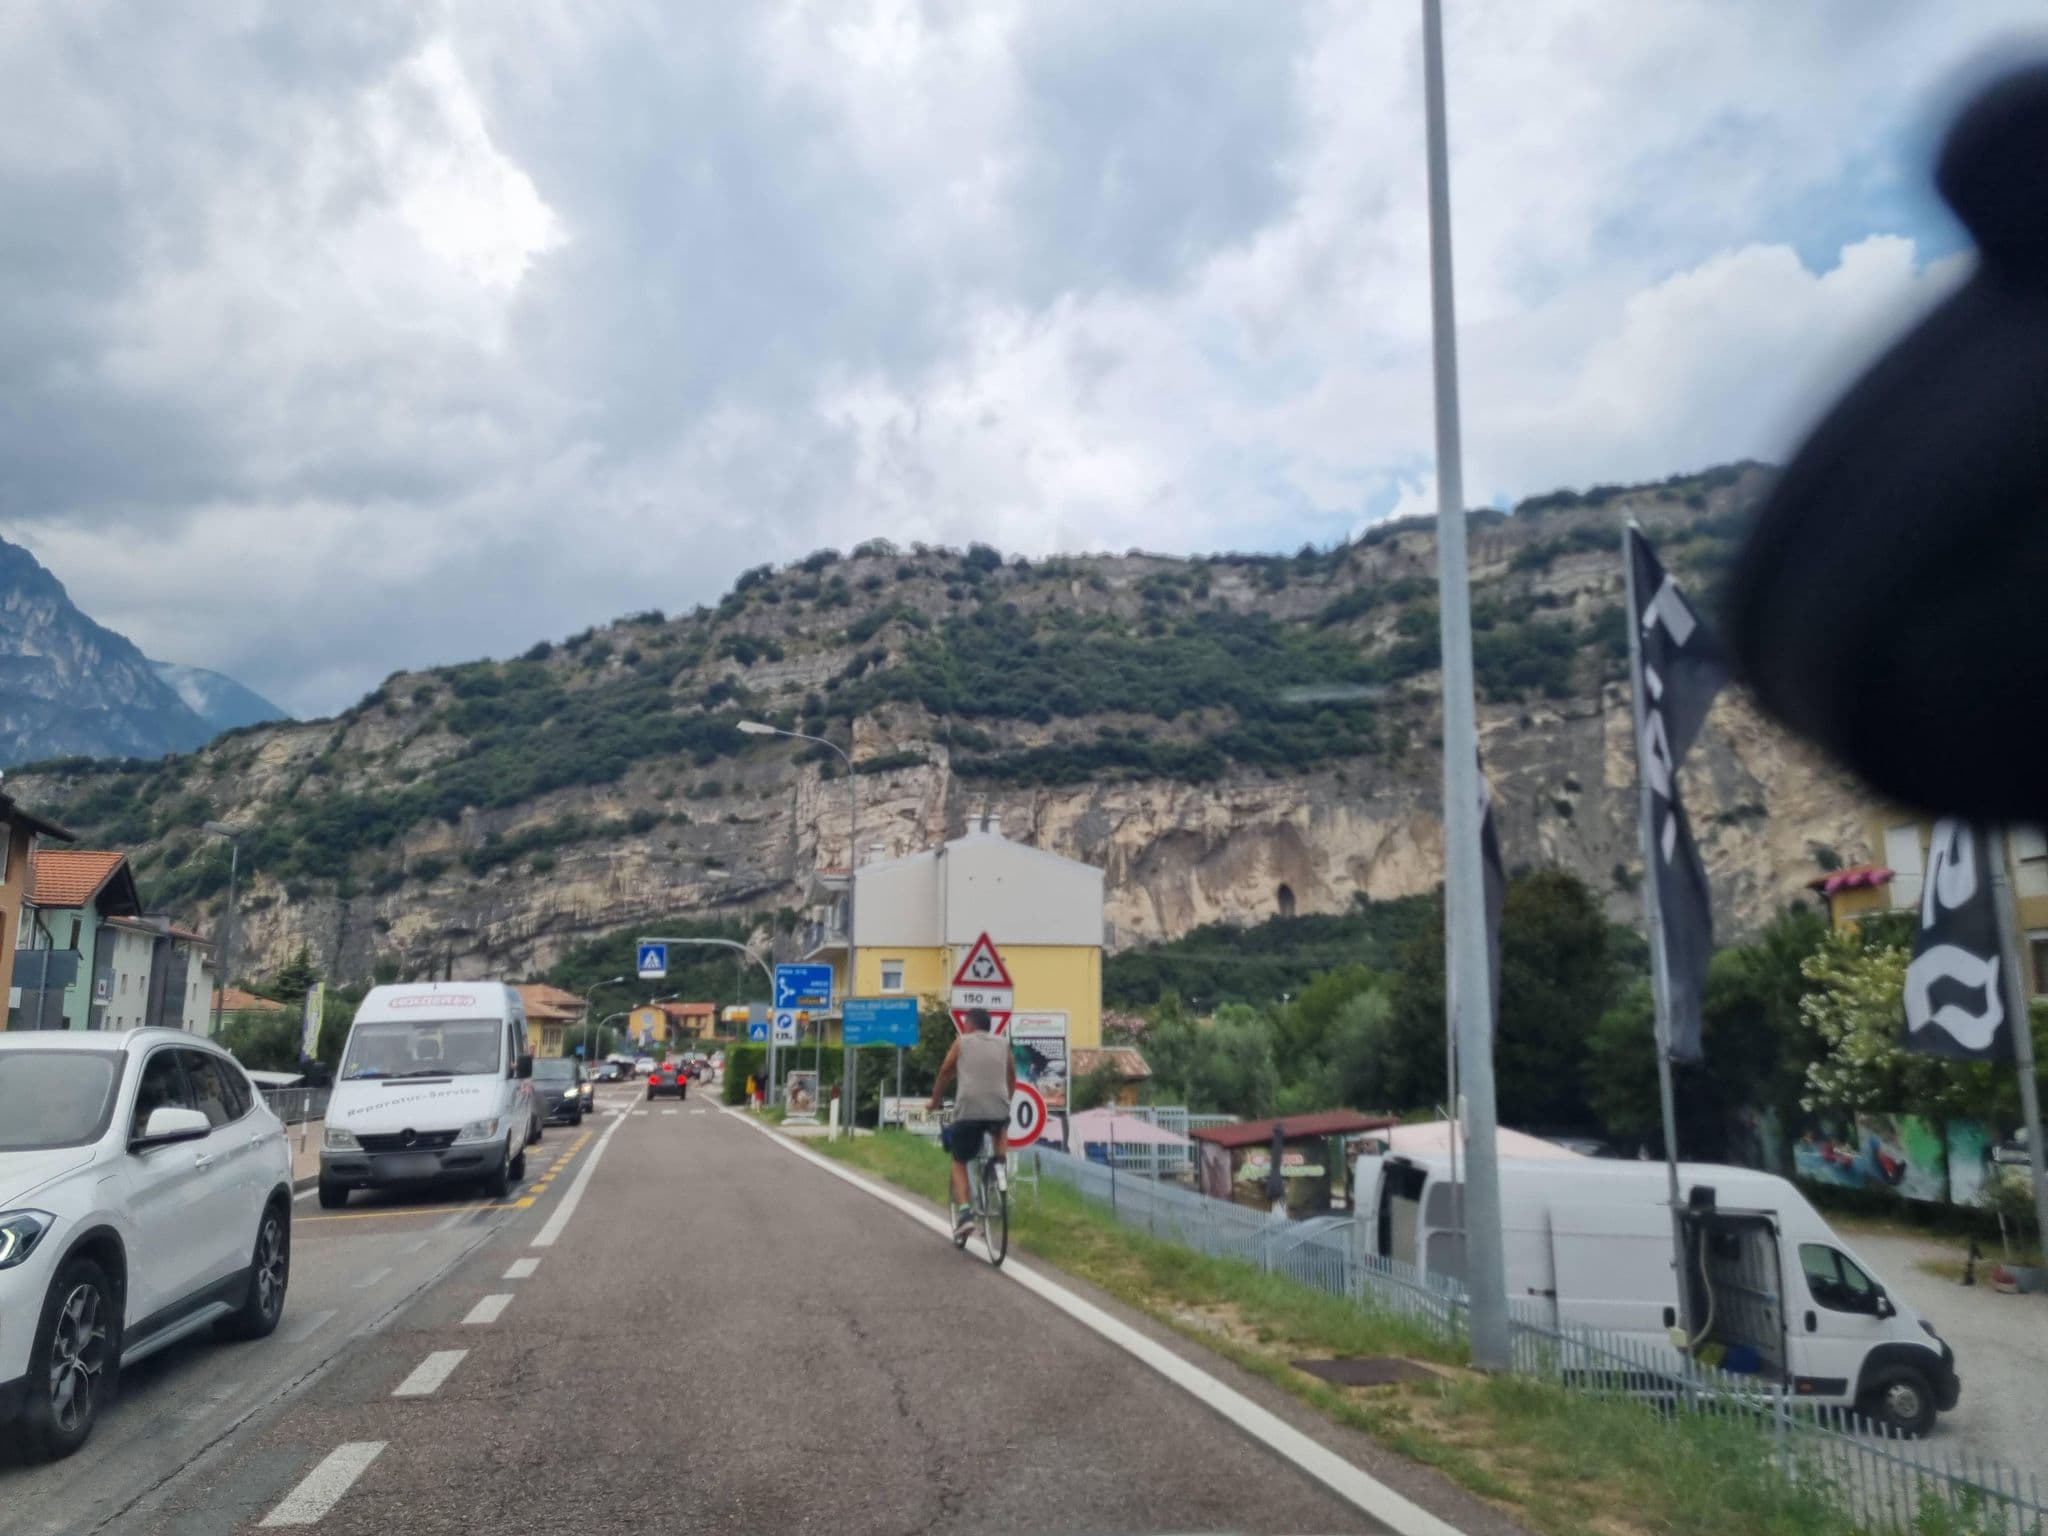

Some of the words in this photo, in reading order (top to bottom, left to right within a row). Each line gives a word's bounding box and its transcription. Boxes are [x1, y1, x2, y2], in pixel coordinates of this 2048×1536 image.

[964, 993, 983, 1004] 150
[991, 996, 1002, 1004] m
[347, 1087, 480, 1117] Reparatur-Service
[1017, 1101, 1033, 1128] 0
